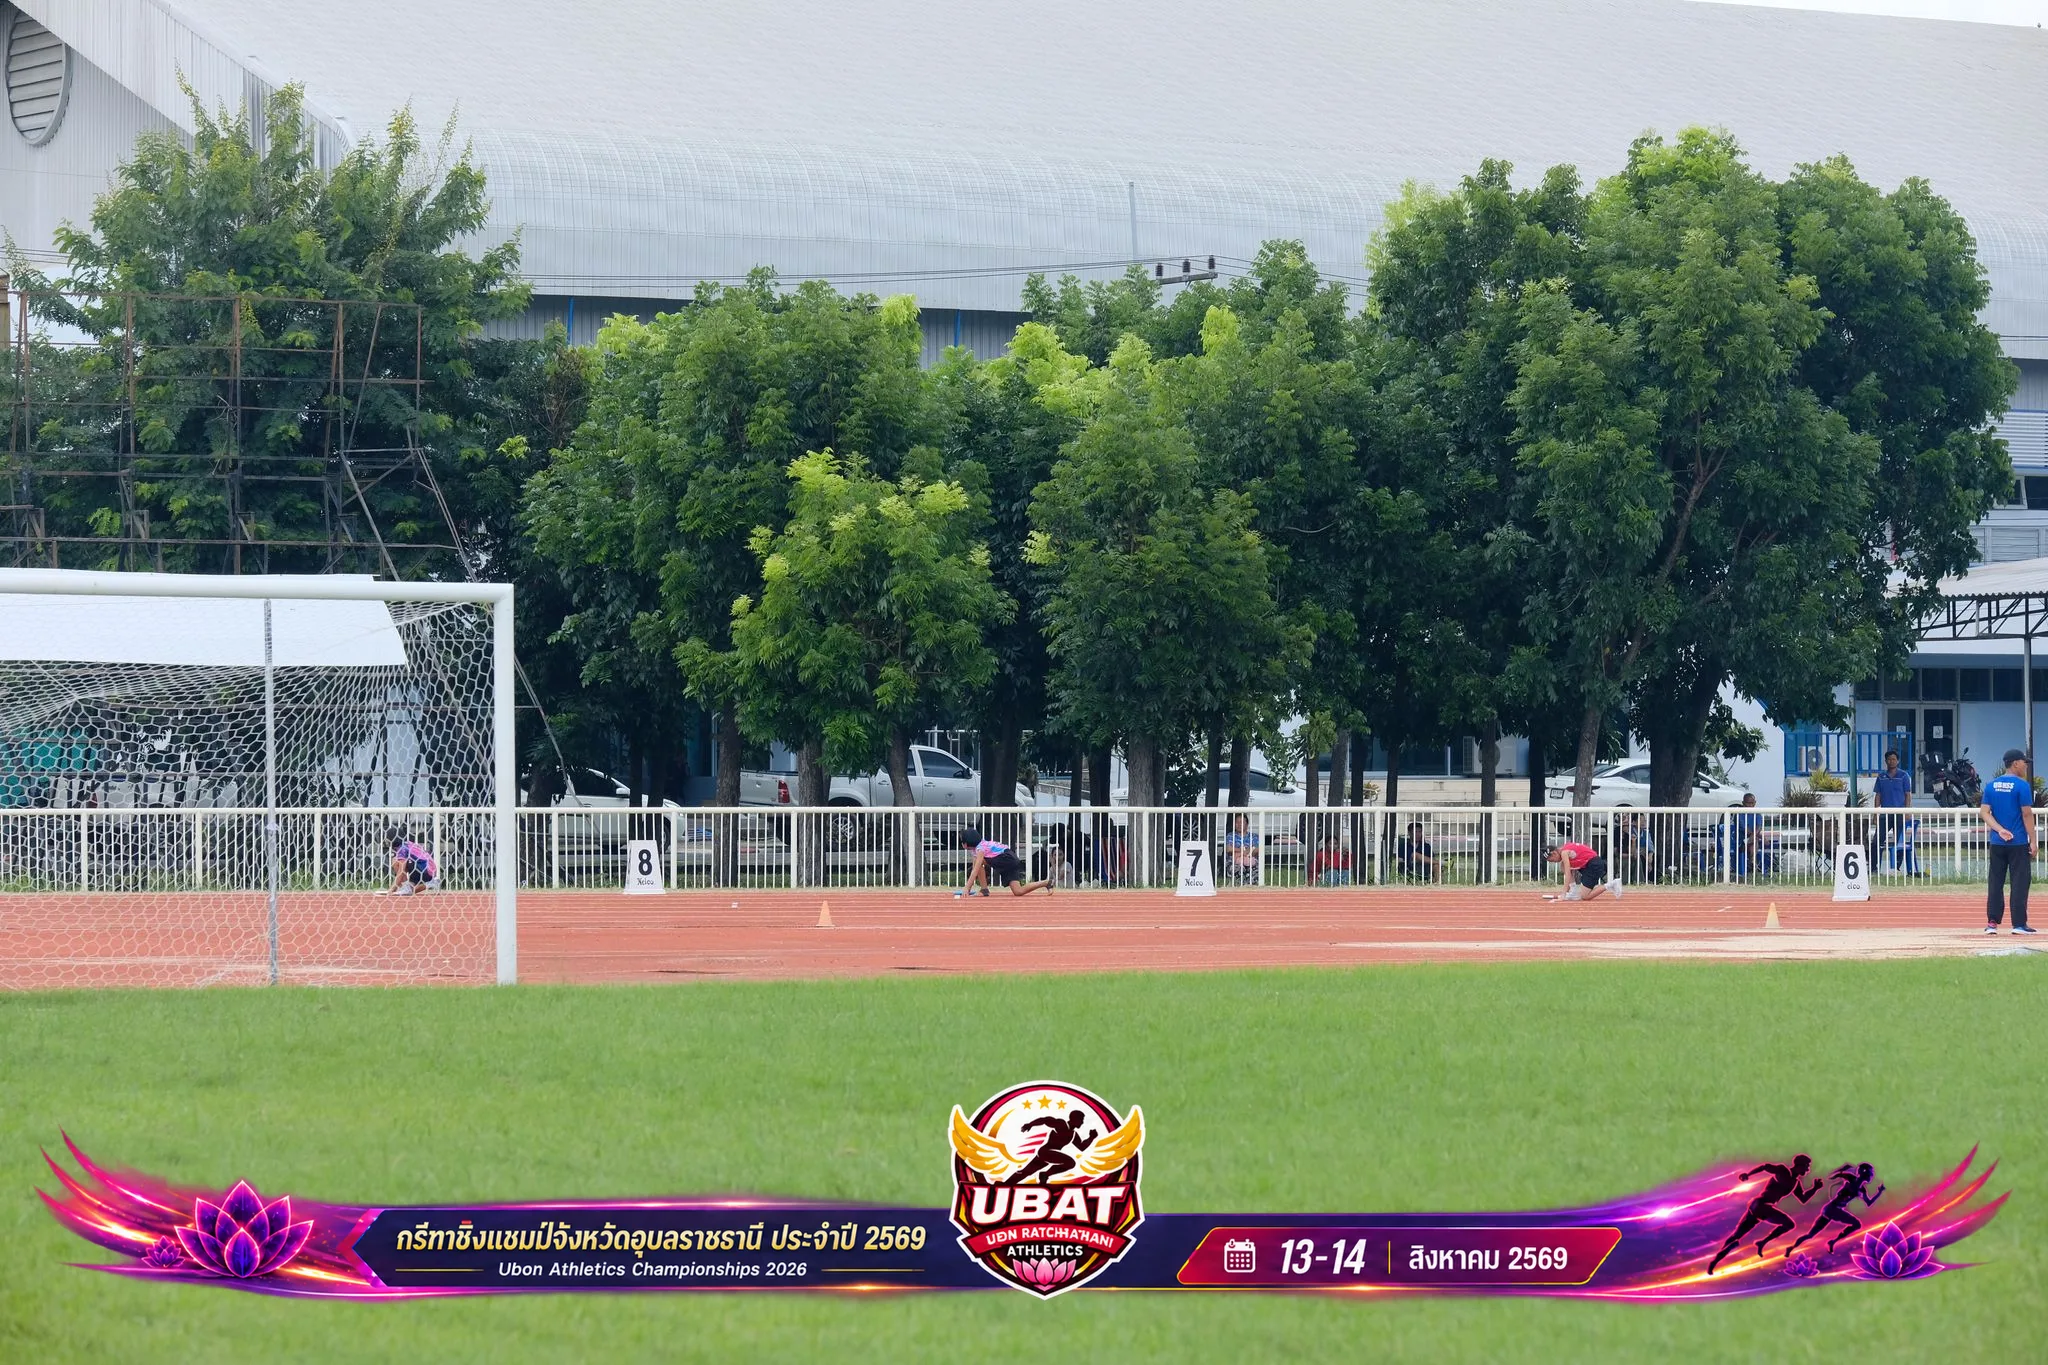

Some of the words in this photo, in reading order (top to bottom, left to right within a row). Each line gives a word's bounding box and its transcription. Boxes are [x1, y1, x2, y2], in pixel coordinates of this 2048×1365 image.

[638, 849, 653, 875] 8
[1186, 849, 1203, 877] 7
[1843, 851, 1860, 880] 6
